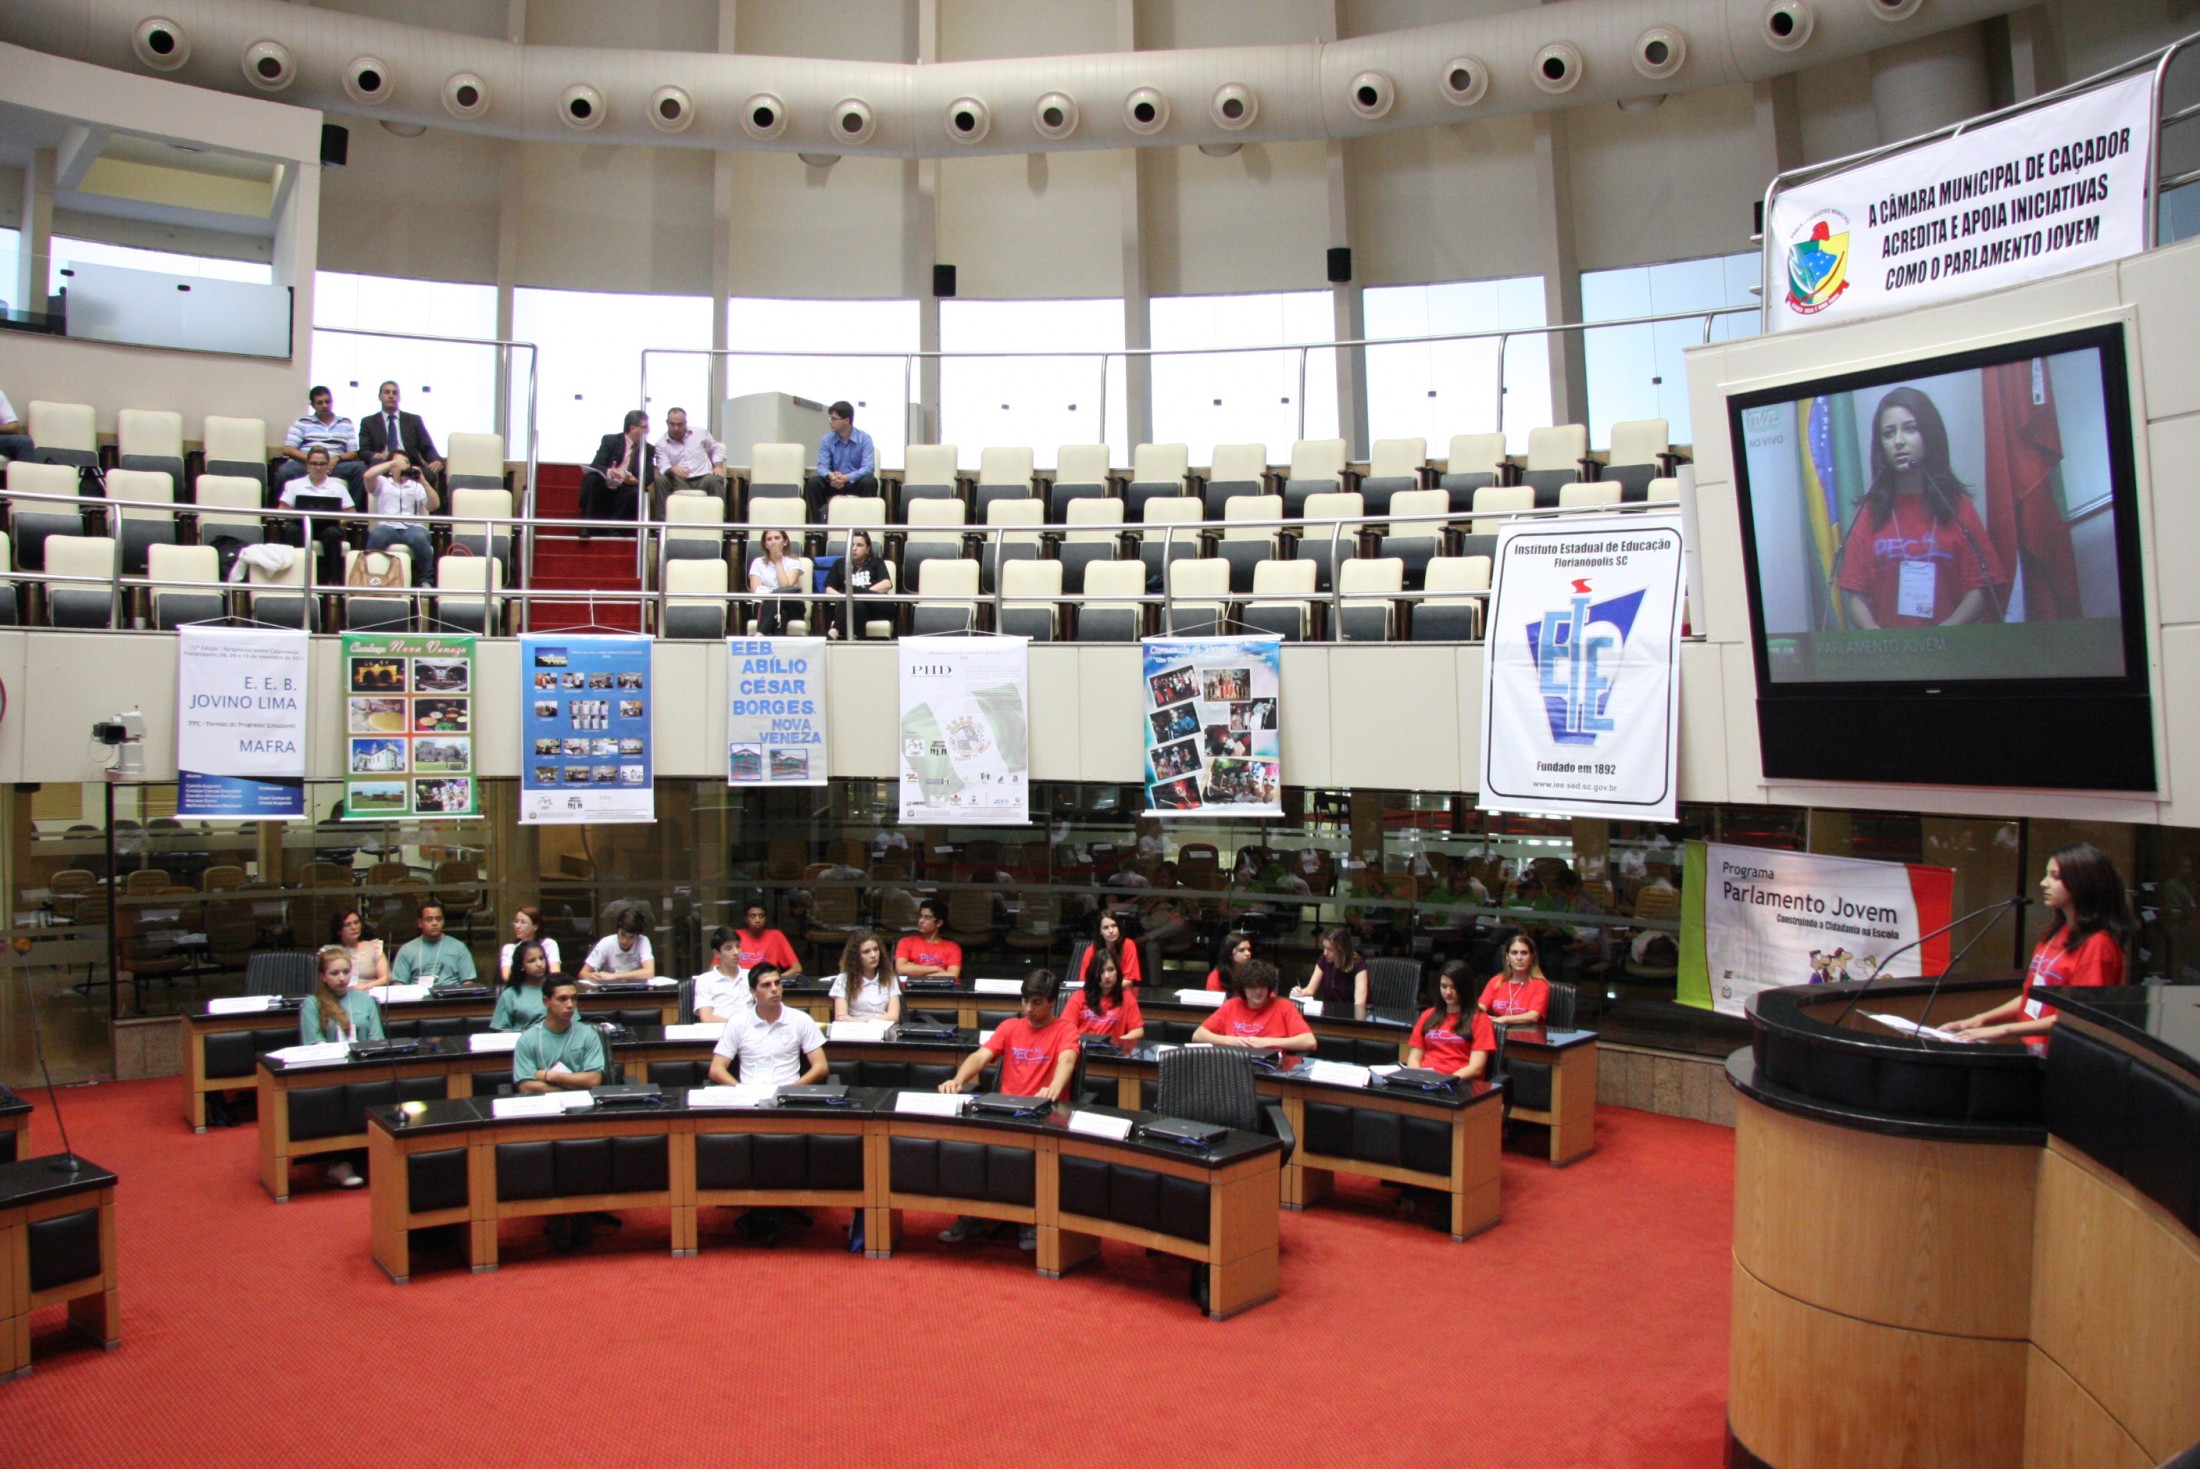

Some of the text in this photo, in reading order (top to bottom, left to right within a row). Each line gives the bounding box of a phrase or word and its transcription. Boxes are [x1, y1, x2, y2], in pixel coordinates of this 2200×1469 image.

[1869, 127, 2130, 228] A CÂMARA MUNICIPAL DE CAÇADOR
[1882, 173, 2108, 259] ACREDITA E APOIA INICIATIVAS
[1885, 215, 2100, 291] COMO O PARLAMENTO JOVEM
[1762, 435, 1784, 446] VIVO
[1514, 538, 1671, 555] Instituto Estadual de Educação
[1554, 556, 1628, 568] Florianópolis SC
[742, 655, 807, 674] ABÍLIO
[912, 665, 952, 675] PHD
[740, 676, 806, 695] CÉSAR
[189, 694, 297, 711] JOVINO LIMA
[772, 718, 812, 731] NOVA
[239, 739, 296, 753] MAFRA
[759, 731, 821, 744] VENEZA
[1536, 761, 1616, 775] Fundado em 1892
[1533, 781, 1618, 792] www.iee.sed.sc.gov.br
[1722, 861, 1775, 880] Programa
[1723, 881, 1898, 925] Parlamento Jovem
[1776, 913, 1899, 940] Construindo a Cidadania na Escola
